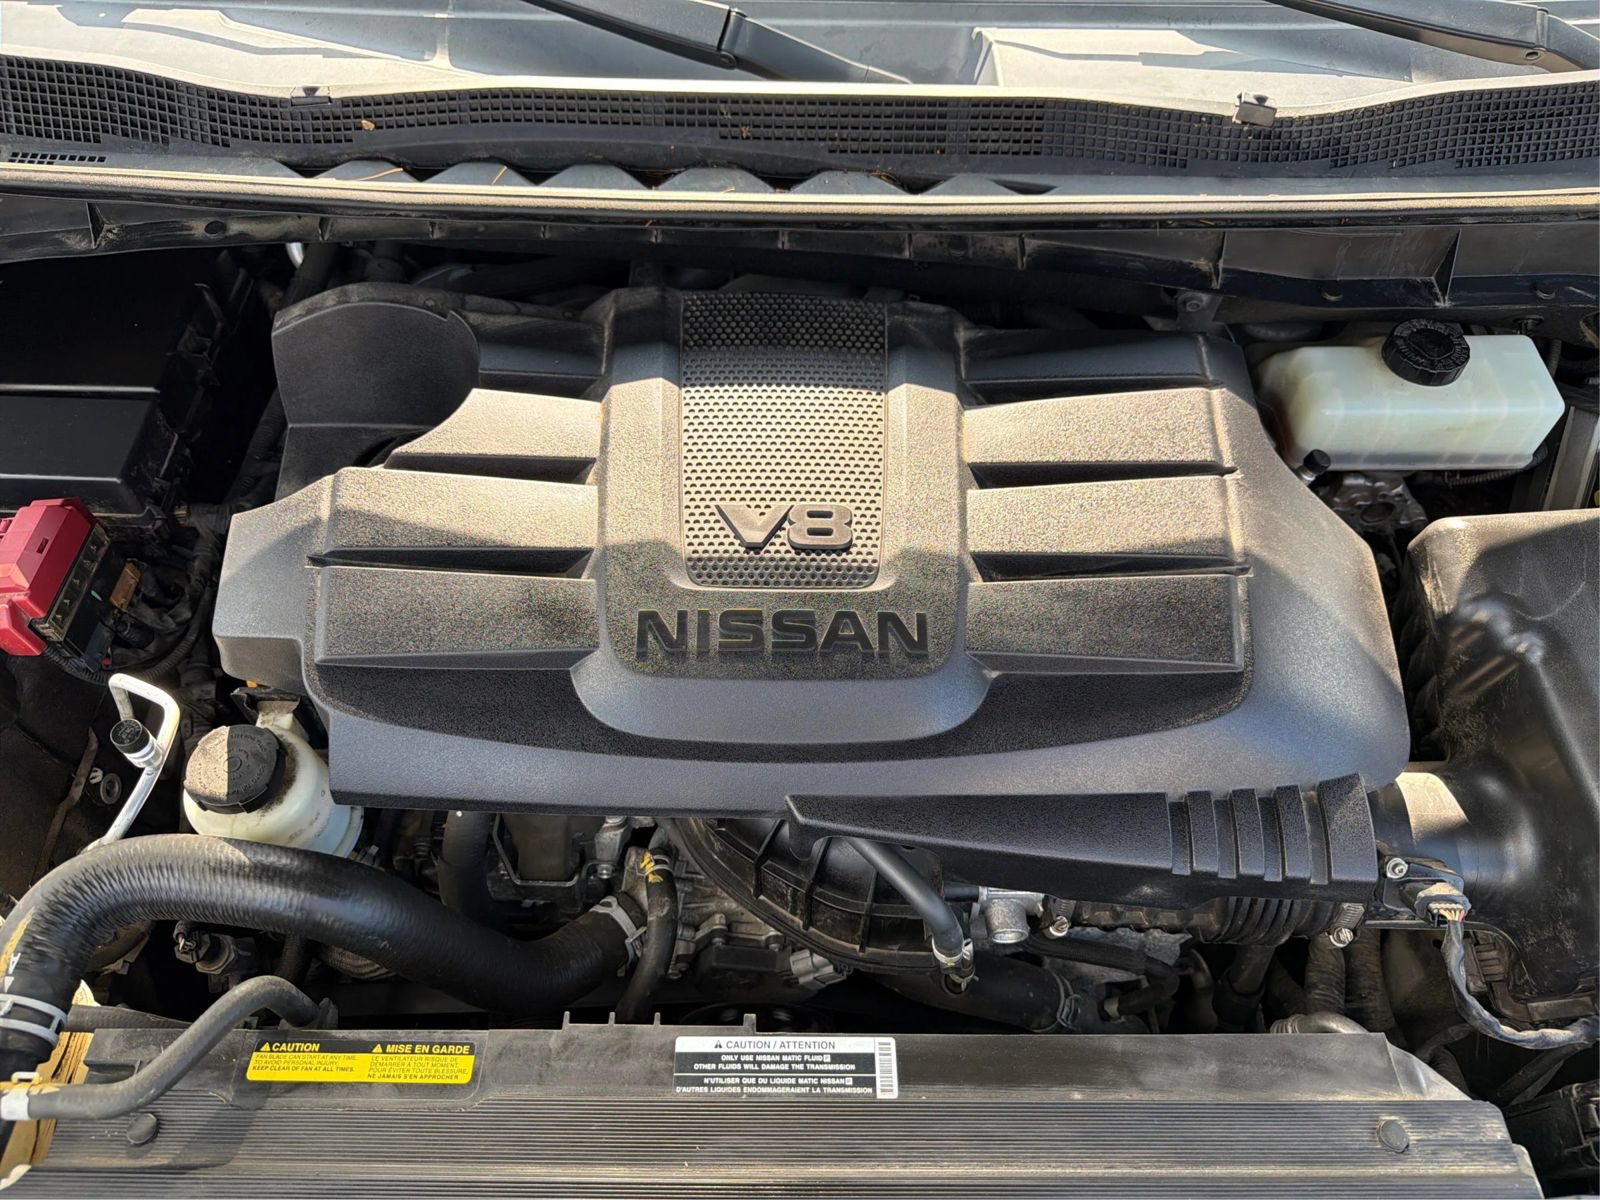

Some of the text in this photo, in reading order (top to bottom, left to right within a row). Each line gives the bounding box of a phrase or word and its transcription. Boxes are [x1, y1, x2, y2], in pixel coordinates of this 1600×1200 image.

[714, 504, 853, 550] V8
[636, 609, 929, 655] NISSAN
[272, 1042, 320, 1052] CAUTION
[386, 1044, 470, 1054] MISE EN GARDE
[726, 1041, 835, 1050] CAUTION / ATTENTION
